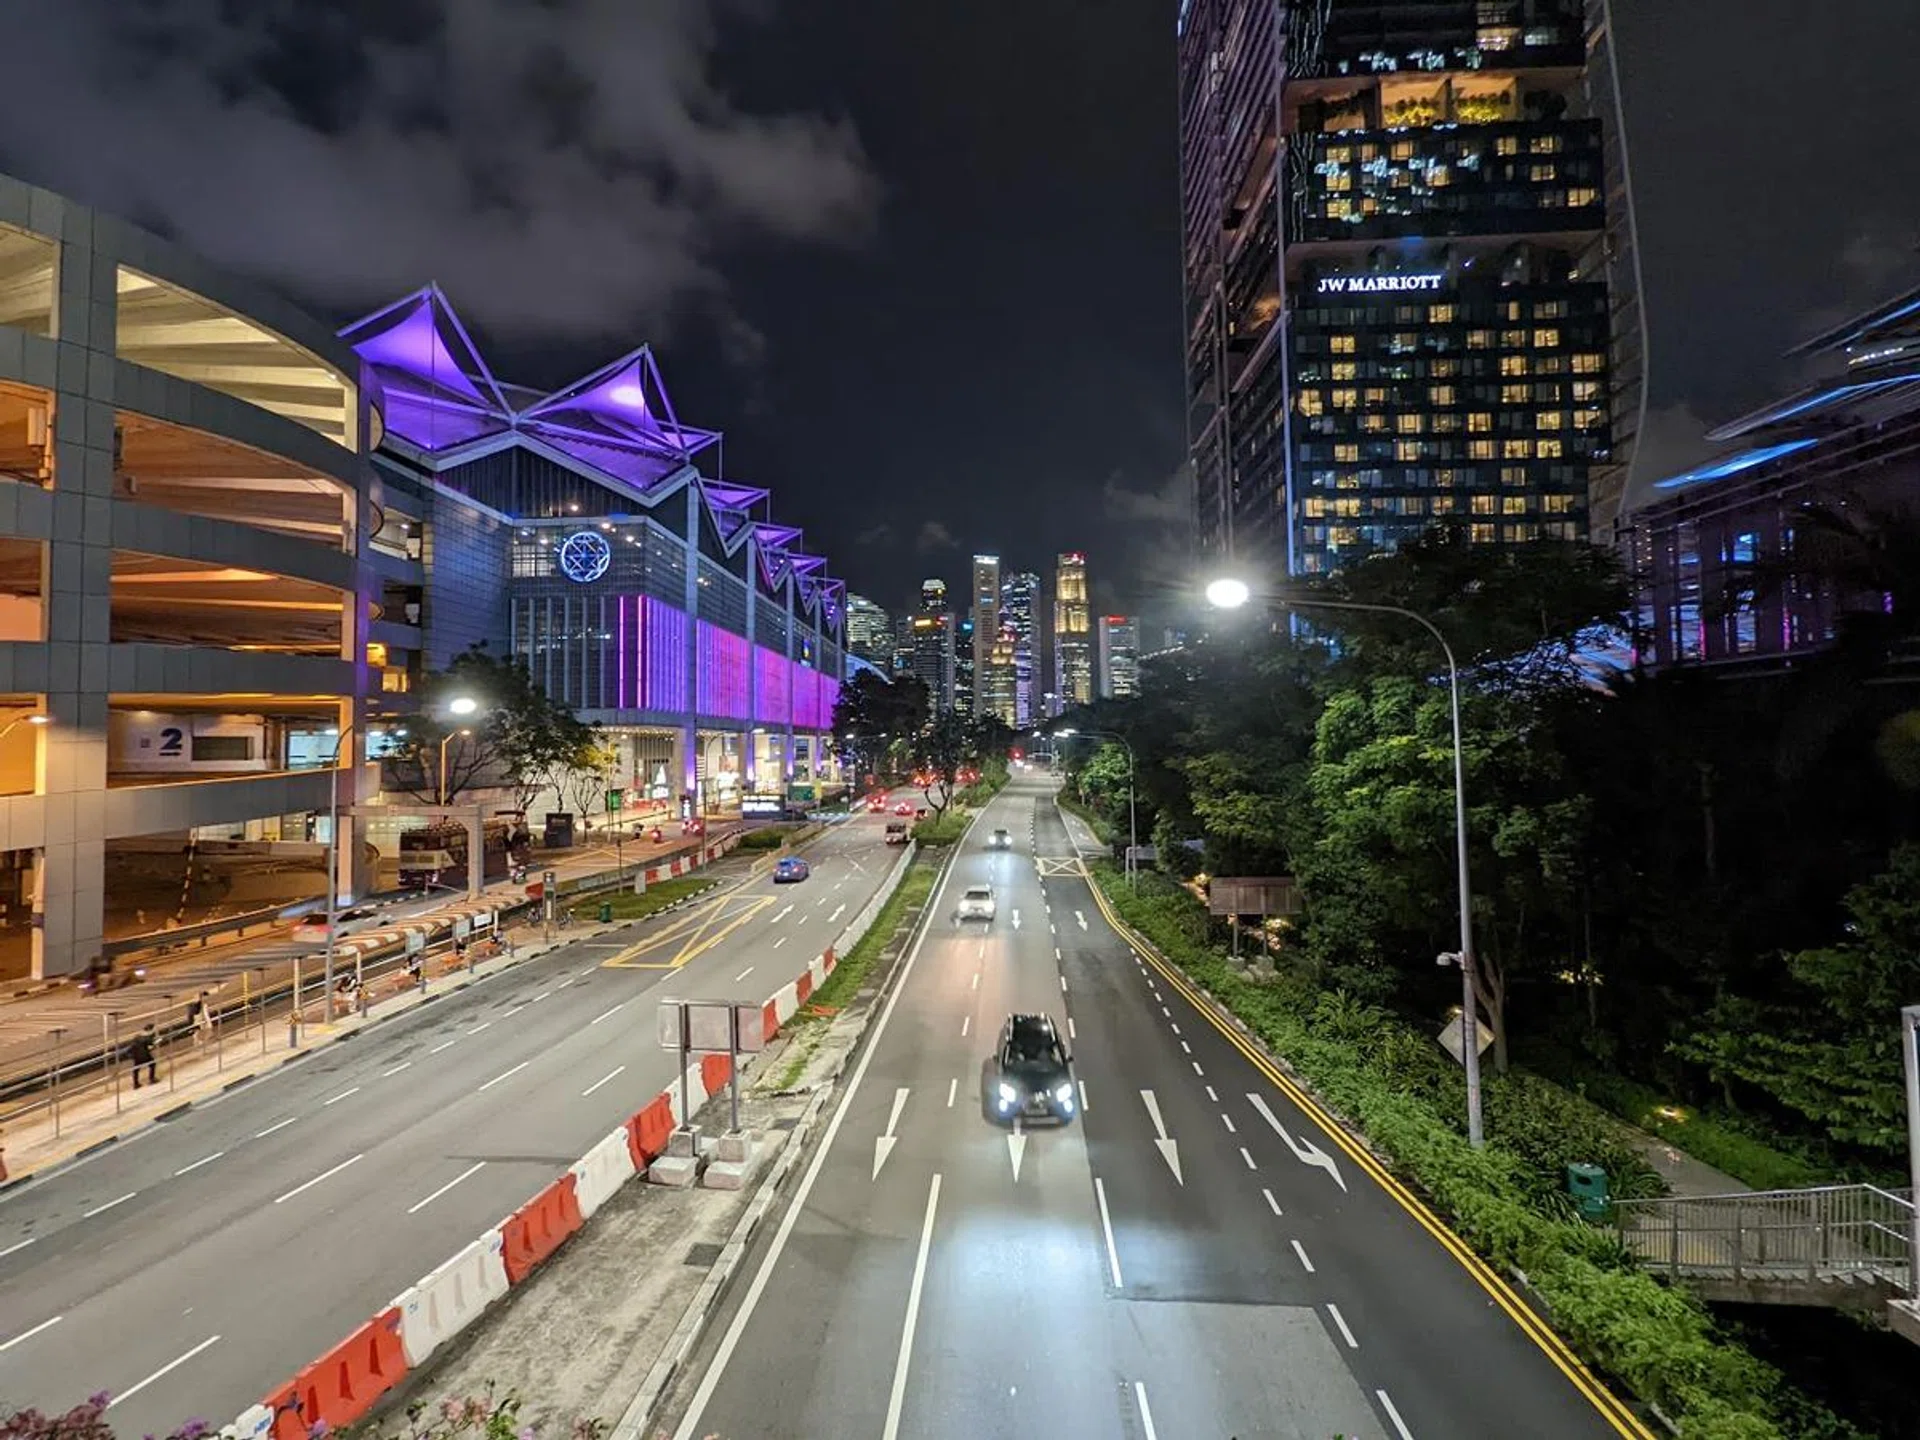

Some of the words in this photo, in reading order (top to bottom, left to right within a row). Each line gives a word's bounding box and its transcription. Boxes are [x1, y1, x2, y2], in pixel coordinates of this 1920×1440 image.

[1318, 278, 1346, 292] JW
[1347, 275, 1441, 291] MARRIOTT
[160, 727, 182, 750] 2
